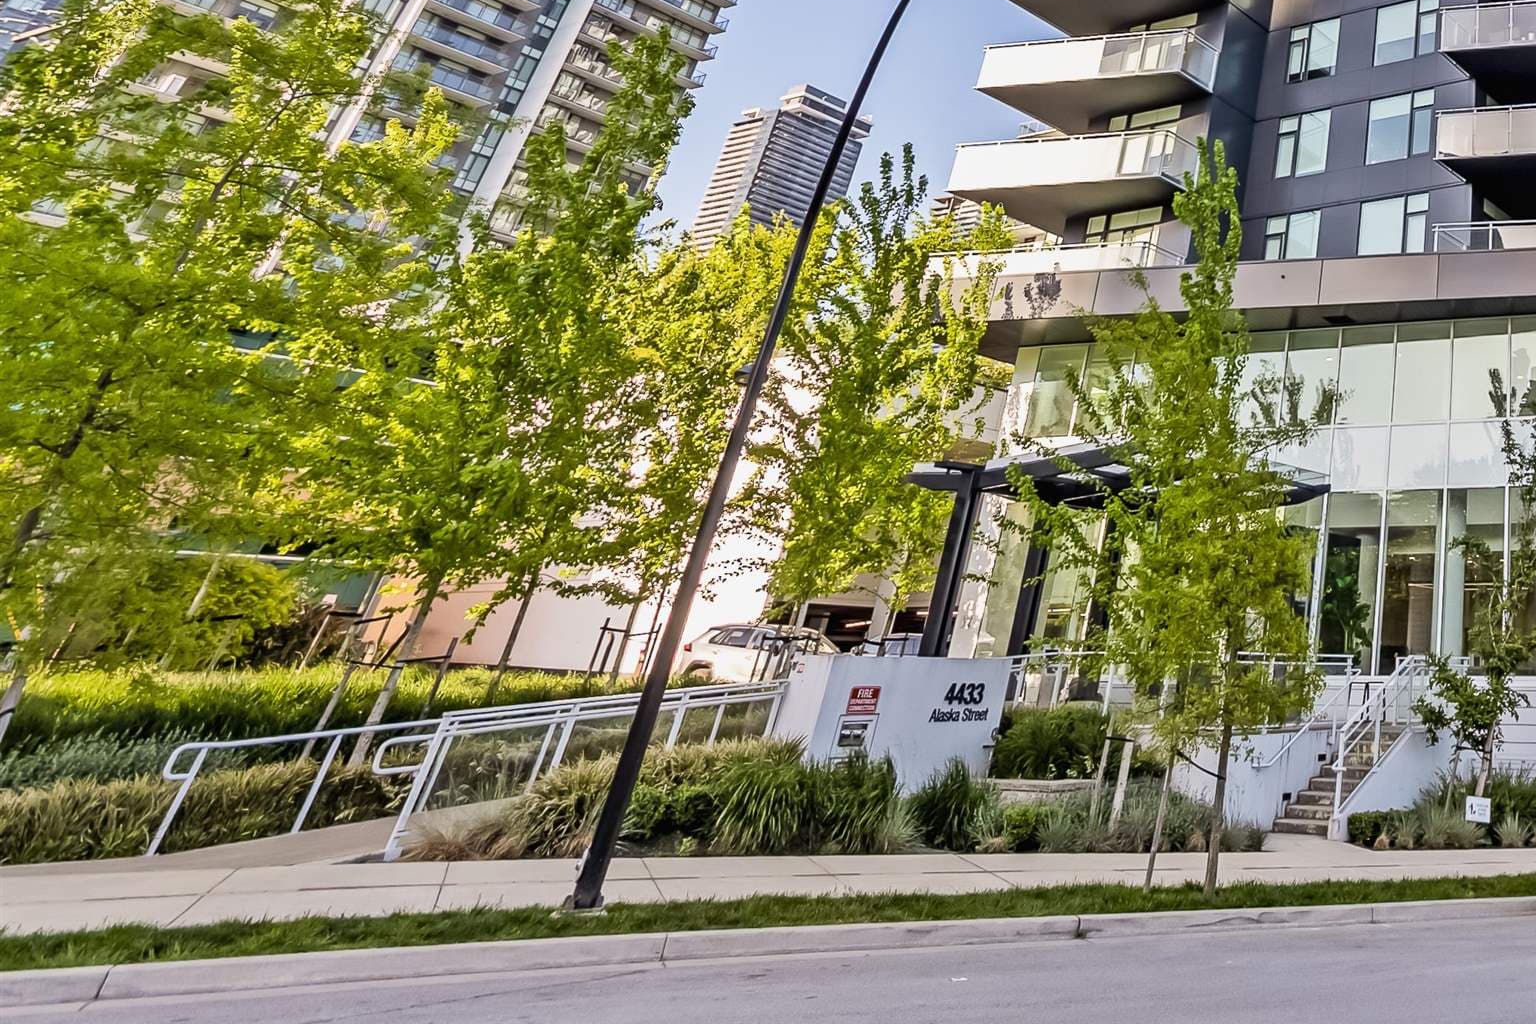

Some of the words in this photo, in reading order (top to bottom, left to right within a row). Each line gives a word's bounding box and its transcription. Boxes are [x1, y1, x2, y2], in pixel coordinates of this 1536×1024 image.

[857, 688, 874, 698] FIRE
[944, 682, 985, 705] 4433
[928, 708, 960, 723] Alaska
[961, 707, 989, 722] Street
